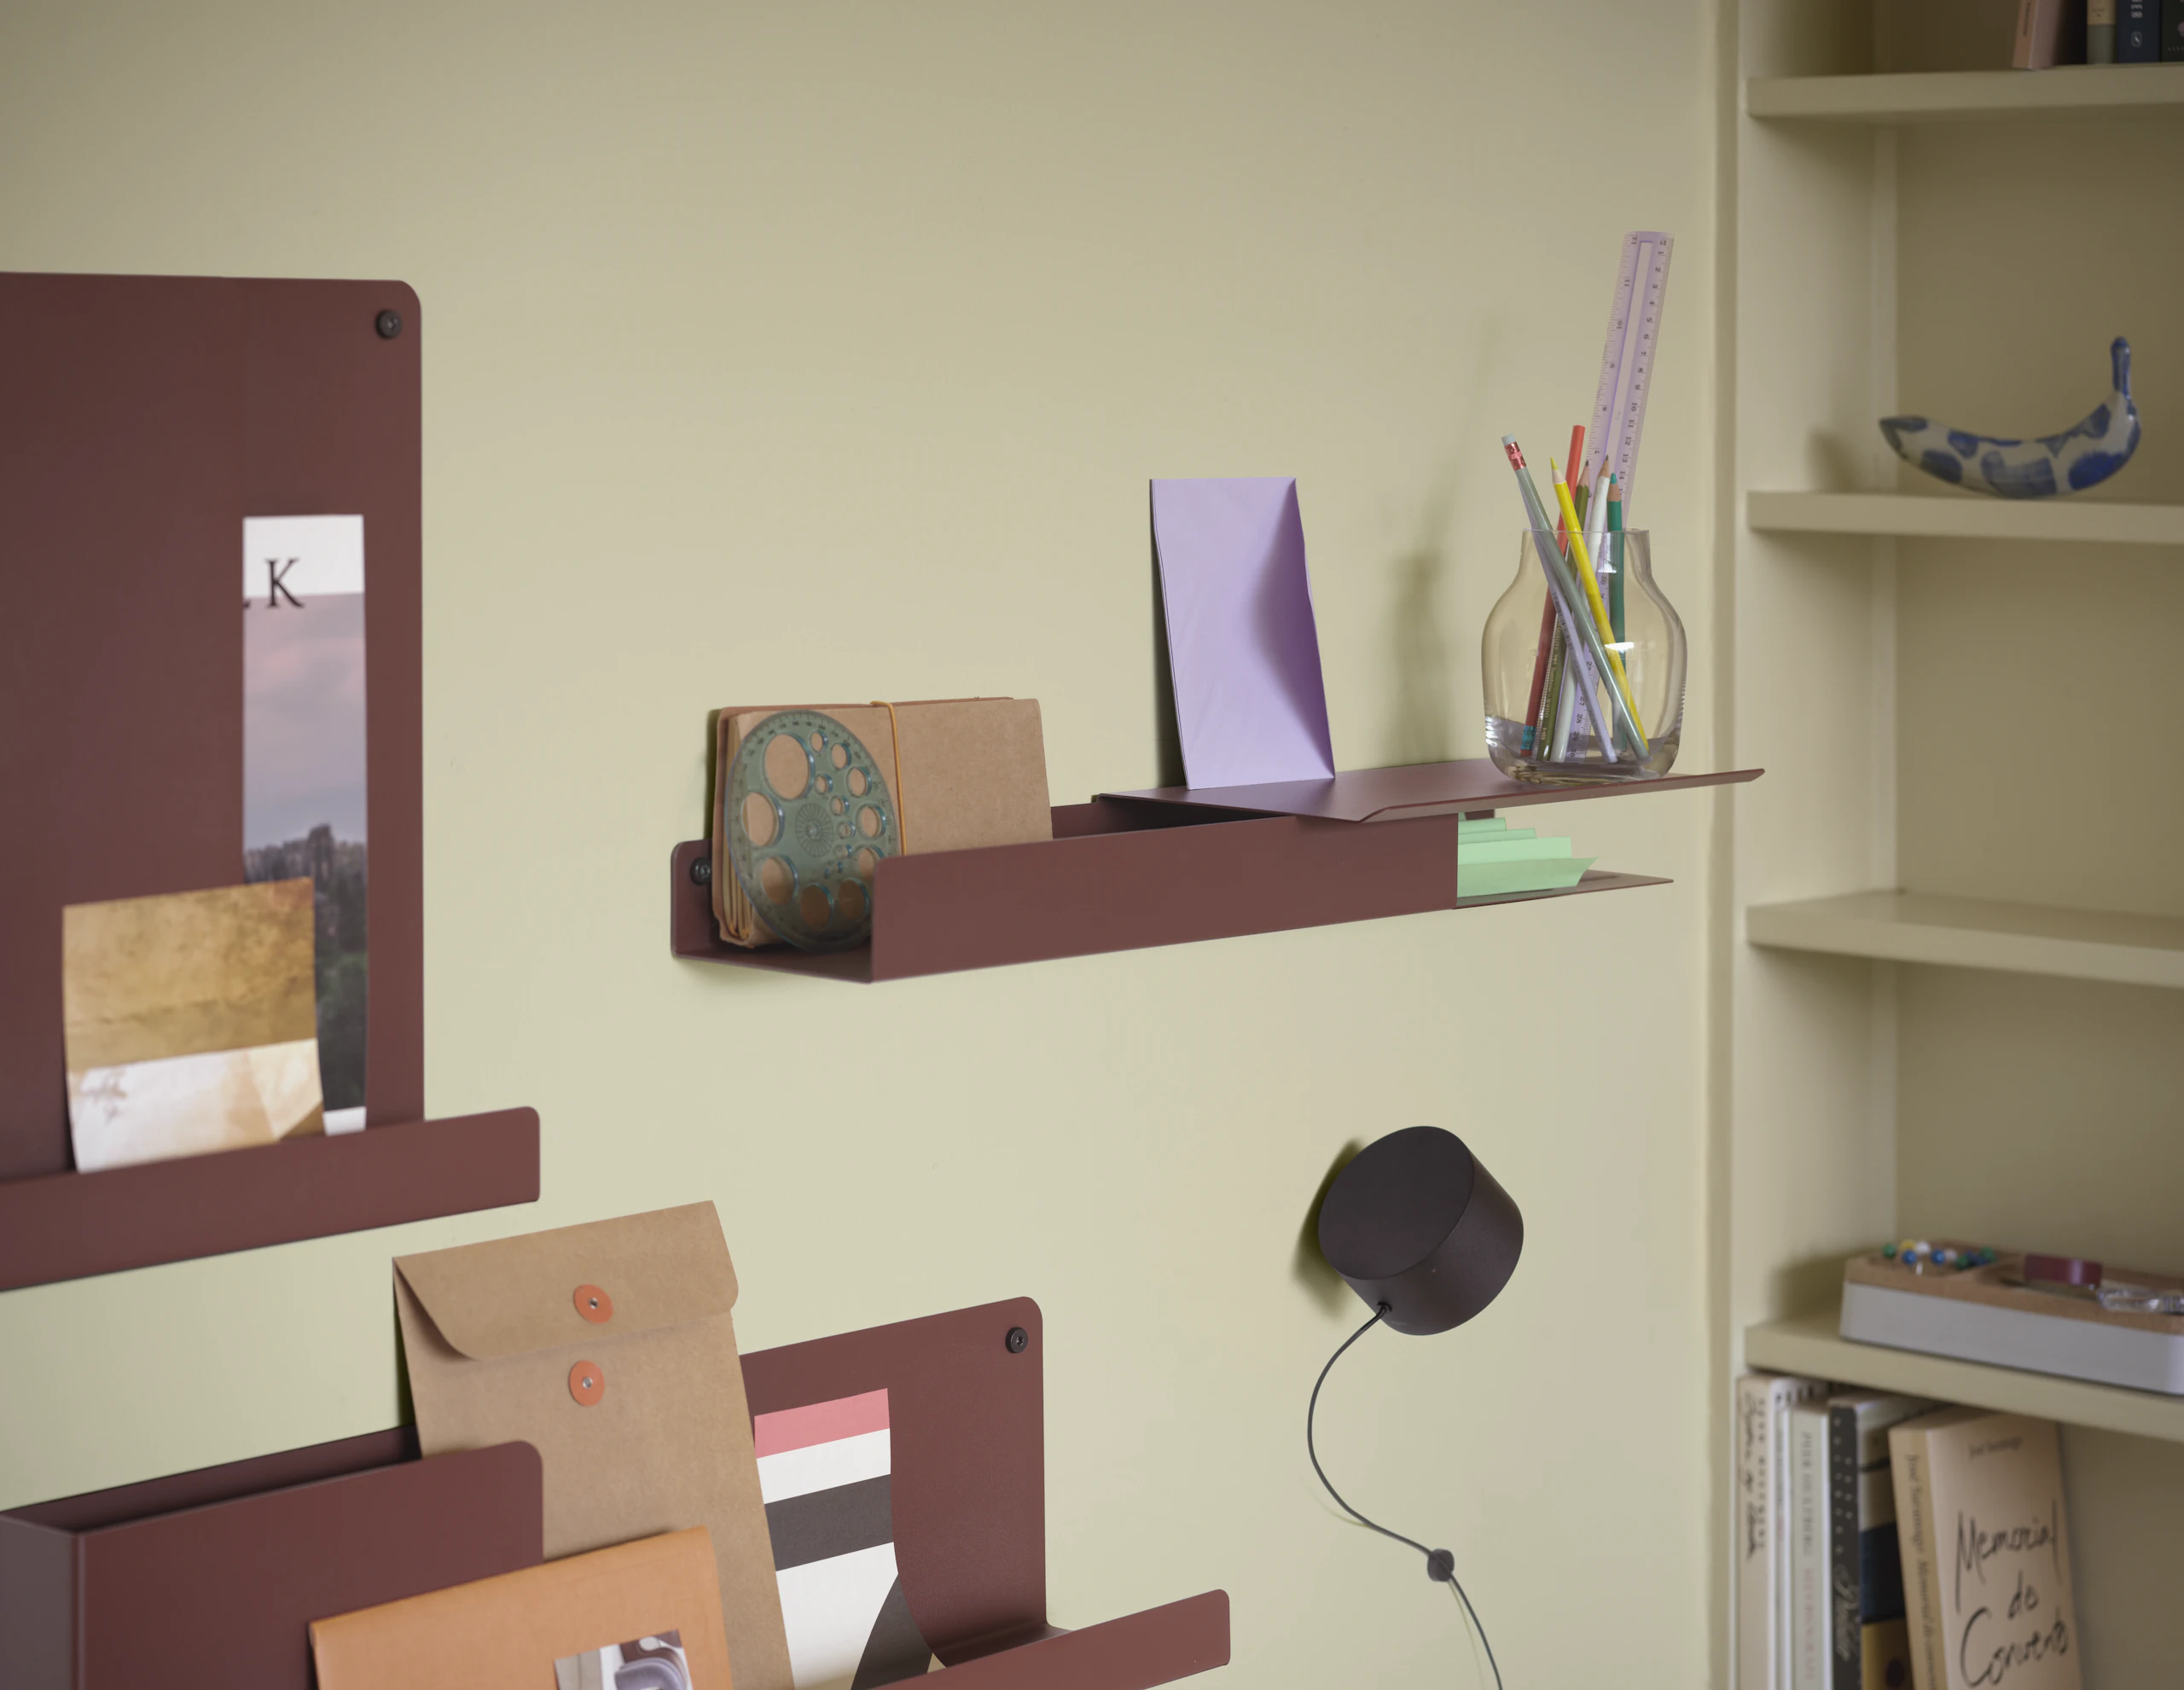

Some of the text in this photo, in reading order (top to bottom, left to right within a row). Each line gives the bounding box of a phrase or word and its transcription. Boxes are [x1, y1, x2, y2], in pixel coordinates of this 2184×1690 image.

[1631, 402, 1637, 411] 10
[1628, 420, 1635, 428] 11
[1624, 436, 1631, 445] 12
[1622, 453, 1629, 462] 13
[1618, 471, 1626, 479] 14
[245, 557, 305, 608] K
[1600, 575, 1606, 585] 20
[1576, 713, 1583, 724] 28
[1541, 728, 1547, 740] HB
[1573, 731, 1579, 741] 29
[1570, 747, 1577, 758] 30
[1955, 1497, 2062, 1614] Memorial
[2008, 1569, 2039, 1621] do
